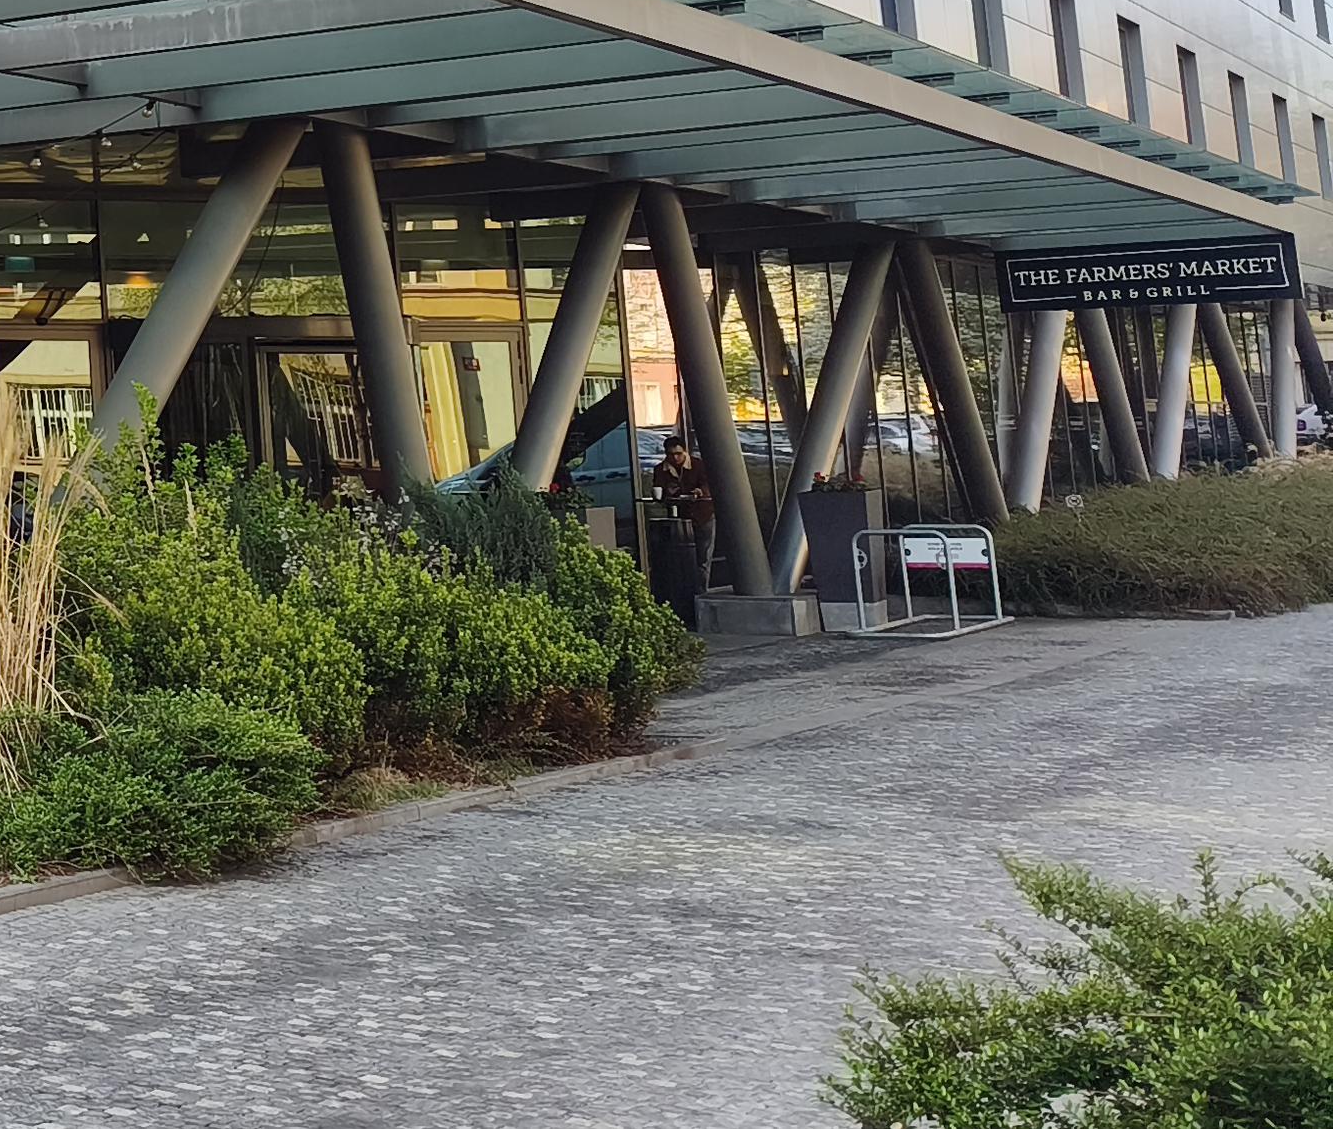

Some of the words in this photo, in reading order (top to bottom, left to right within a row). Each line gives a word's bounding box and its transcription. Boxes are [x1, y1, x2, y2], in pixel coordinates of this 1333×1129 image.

[1013, 269, 1061, 286] THE
[1179, 256, 1277, 279] MARKET
[1083, 288, 1123, 302] BAR
[1129, 287, 1139, 299] &
[1146, 284, 1211, 299] GRILL
